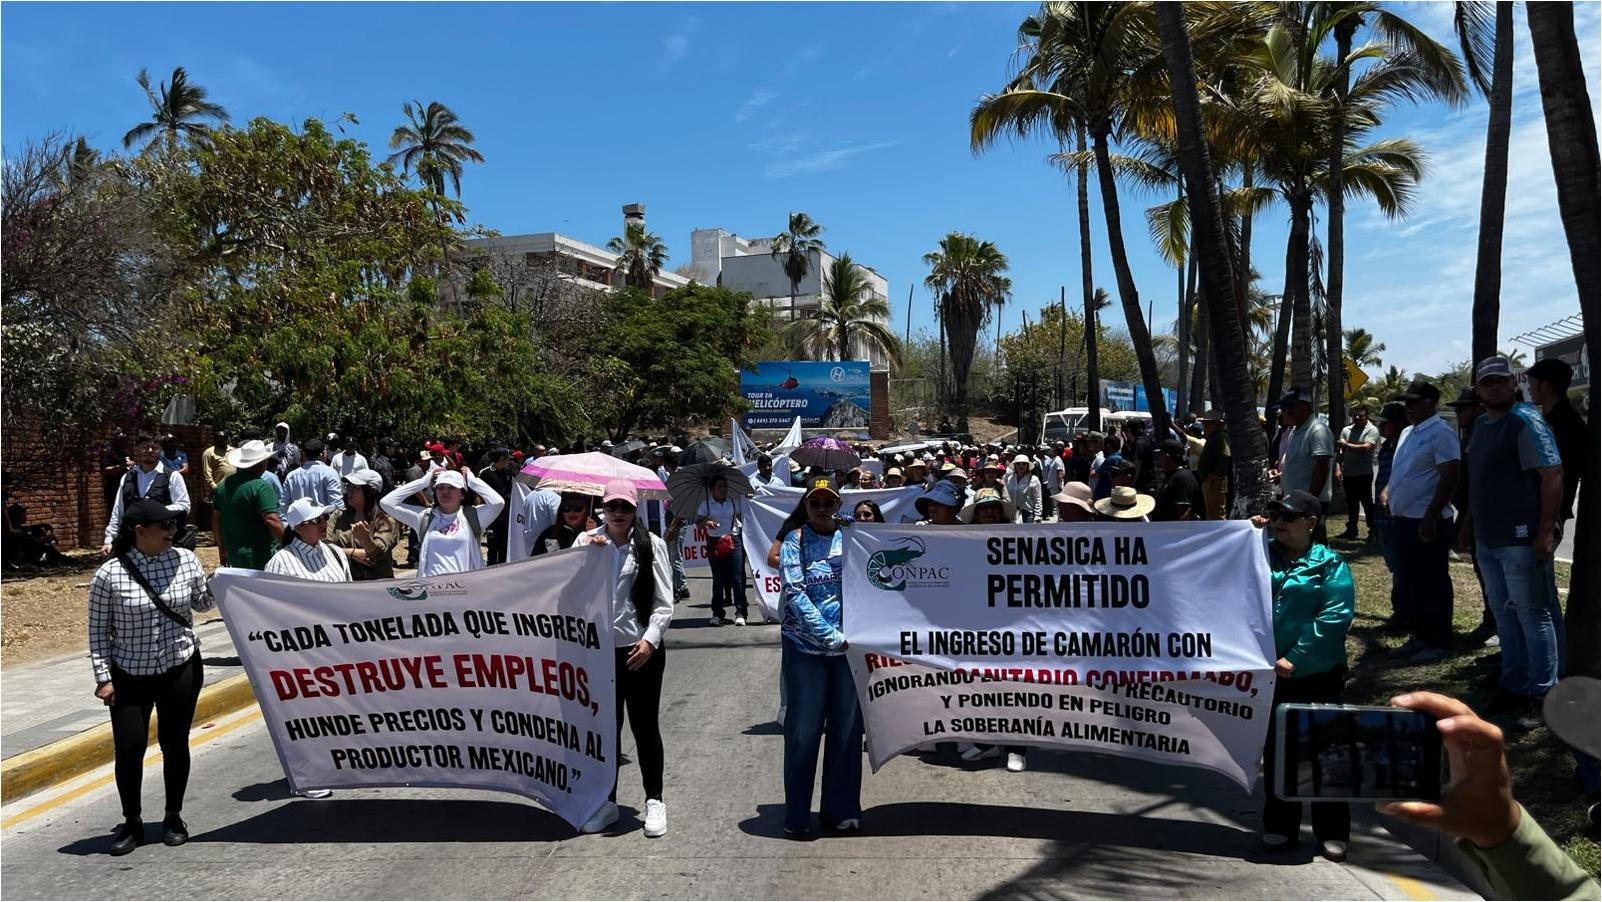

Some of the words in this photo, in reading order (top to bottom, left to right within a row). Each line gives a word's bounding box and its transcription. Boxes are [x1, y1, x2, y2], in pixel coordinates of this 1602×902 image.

[815, 480, 830, 488] CAT
[684, 546, 698, 560] DE
[987, 536, 1107, 566] SENASICA
[1114, 536, 1149, 565] HA
[987, 573, 1151, 609] PERMITIDO
[334, 611, 461, 645] TONELADA
[465, 610, 509, 640] QUE
[512, 612, 601, 651] INGRESA
[900, 631, 924, 656] EL
[928, 630, 1016, 657] INGRESO
[1022, 631, 1049, 657] DE
[1053, 627, 1162, 658] CAMARÓN
[1167, 632, 1213, 659] CON
[269, 655, 446, 702] DESTRUYE
[454, 653, 600, 718] EMPLEOS,
[868, 671, 976, 702] IGNORANDO
[941, 695, 953, 710] Y
[959, 692, 1053, 711] PONIENDO
[1059, 694, 1084, 713] EN
[1089, 699, 1172, 726] PELIGRO
[284, 712, 367, 742] HUNDE
[371, 707, 465, 734] PRECIOS
[470, 708, 484, 730] Y
[490, 708, 581, 752] CONDENA
[585, 732, 606, 764] AL
[923, 719, 947, 736] LA
[951, 716, 1056, 738] SOBERANÍA
[1060, 721, 1192, 757] ALIMENTARIA
[330, 744, 465, 771] PRODUCTOR
[467, 745, 582, 795] MEXICANO.”
